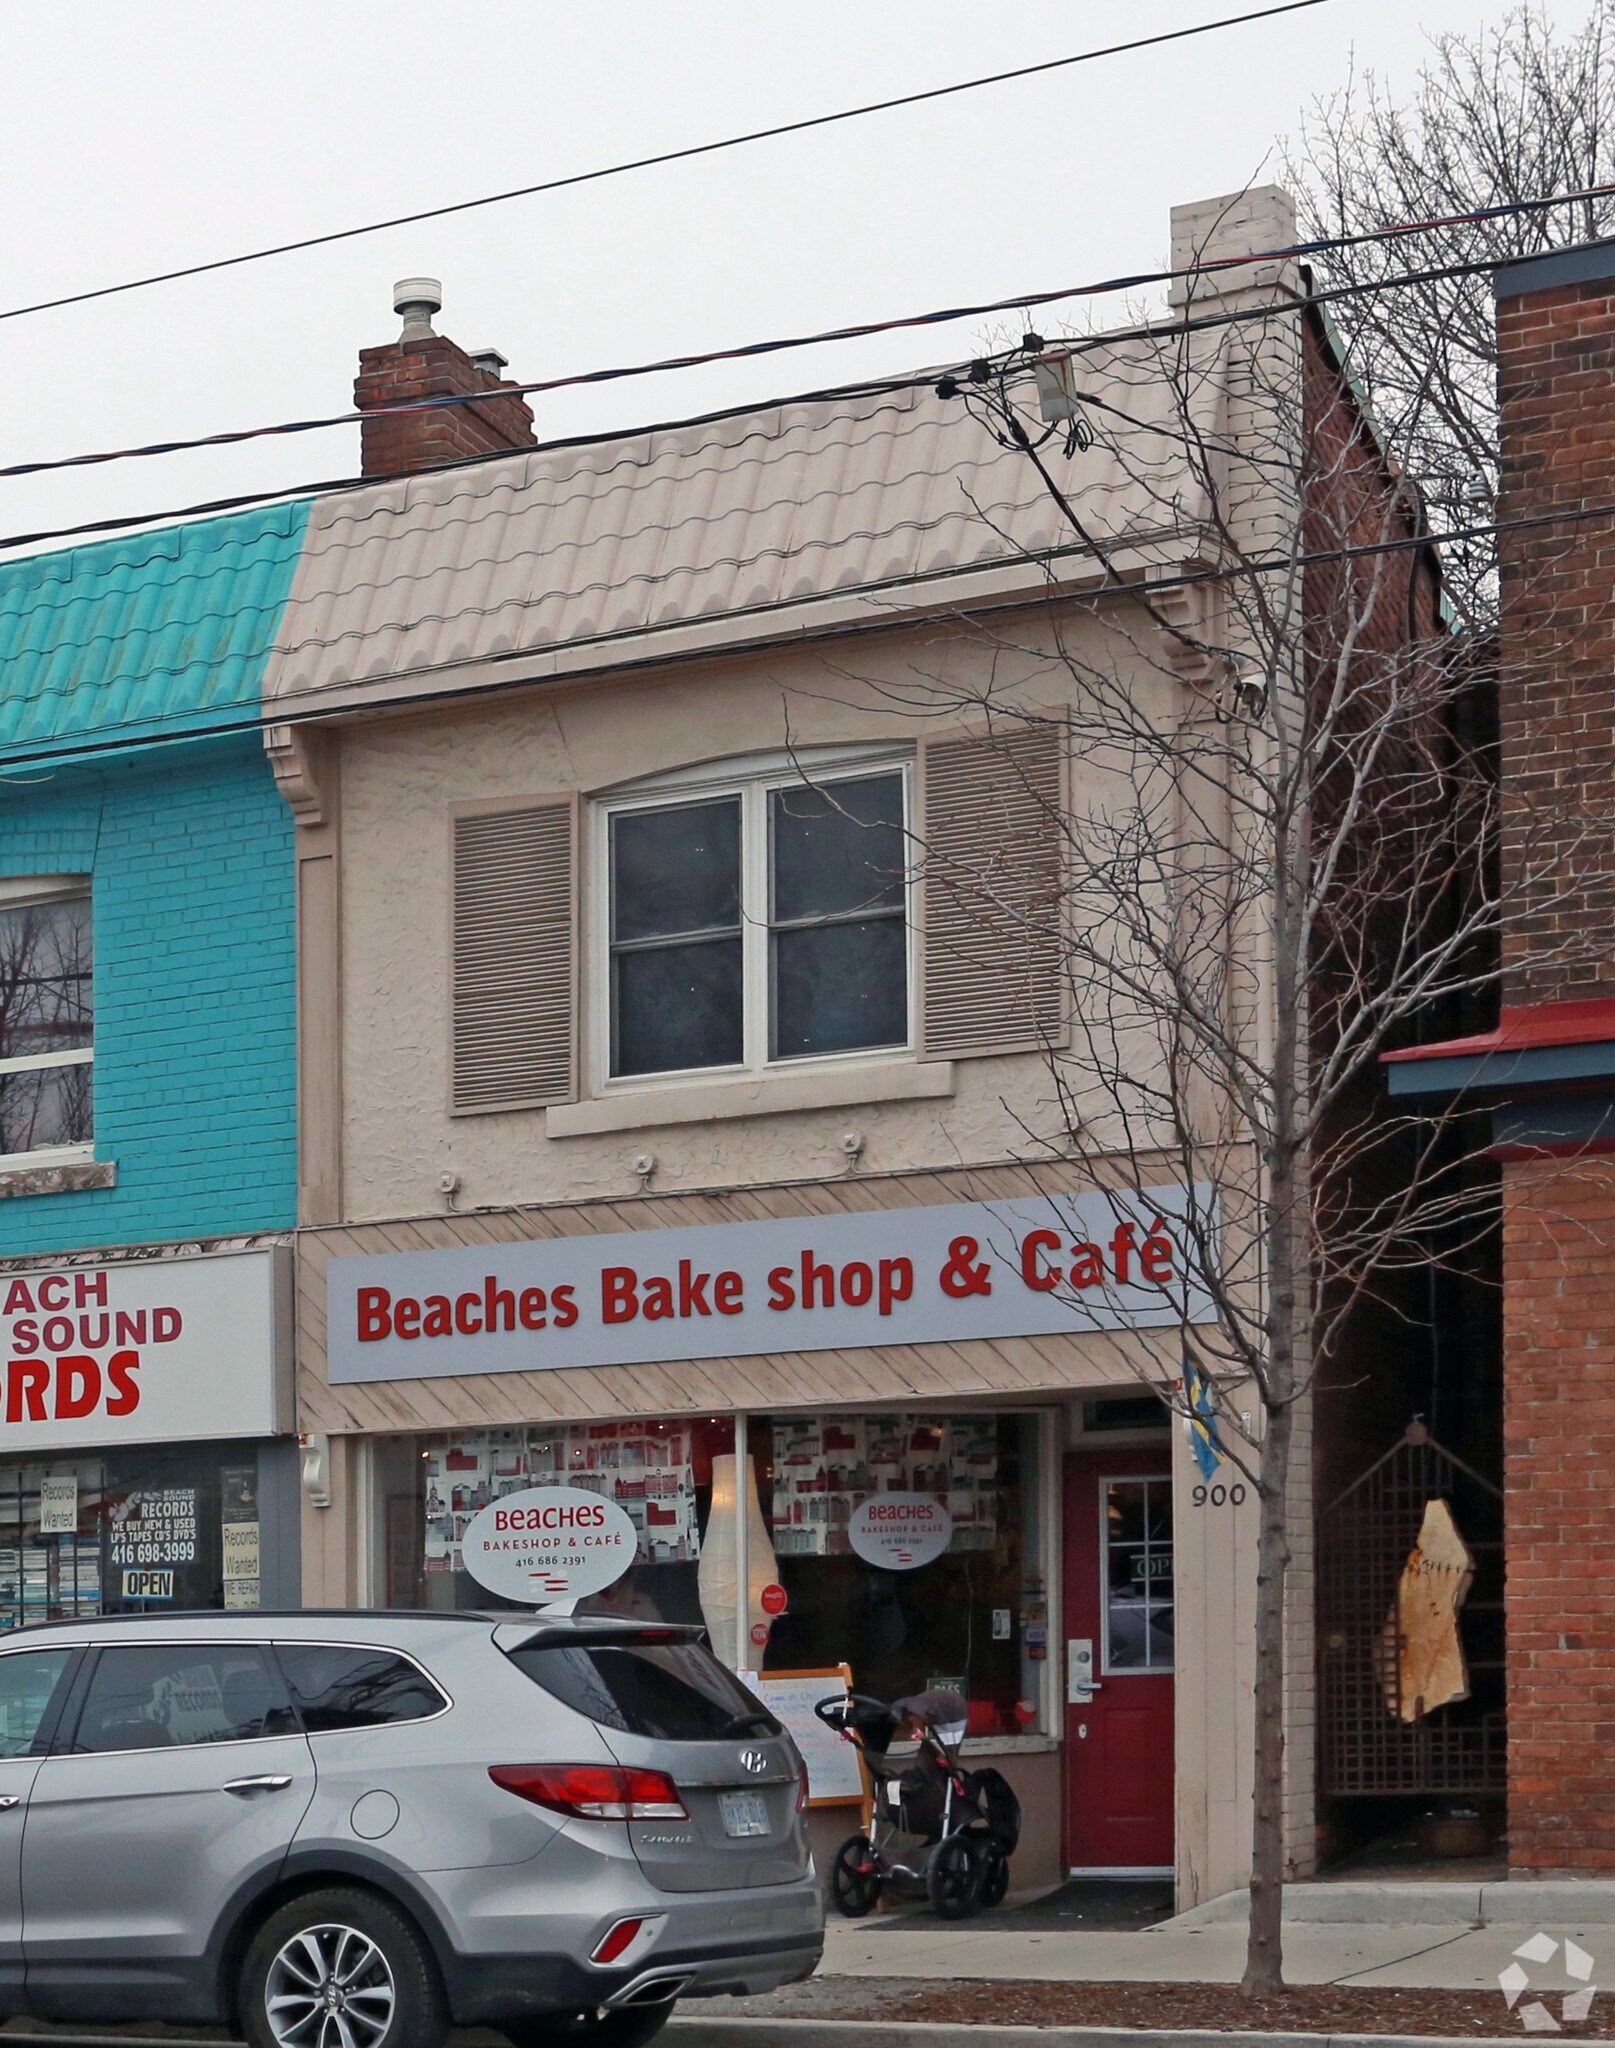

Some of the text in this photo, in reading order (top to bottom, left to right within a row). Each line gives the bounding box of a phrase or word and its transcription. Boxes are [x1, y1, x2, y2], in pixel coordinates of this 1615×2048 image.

[357, 1216, 1173, 1342] Beaches Bake shop & Café
[2, 1271, 108, 1315] ACH
[12, 1306, 183, 1355] SOUND
[0, 1350, 140, 1423] RDS
[1192, 1483, 1246, 1507] 900
[141, 1501, 195, 1518] RECORDS
[112, 1521, 124, 1531] WE
[126, 1520, 141, 1531] BUY
[144, 1519, 162, 1530] NEW
[164, 1519, 172, 1530] &
[173, 1518, 196, 1529] USED
[861, 1525, 908, 1533] BAKESHOP
[128, 1531, 152, 1542] TAPES
[173, 1529, 196, 1540] DVD'S
[224, 1527, 258, 1547] Records
[483, 1532, 622, 1551] BAKESHOP & CAFÉ
[111, 1541, 195, 1564] 416 698-3999
[515, 1555, 586, 1567] 416 686 2391
[226, 1555, 257, 1574] Wanted
[127, 1572, 171, 1596] OPEN
